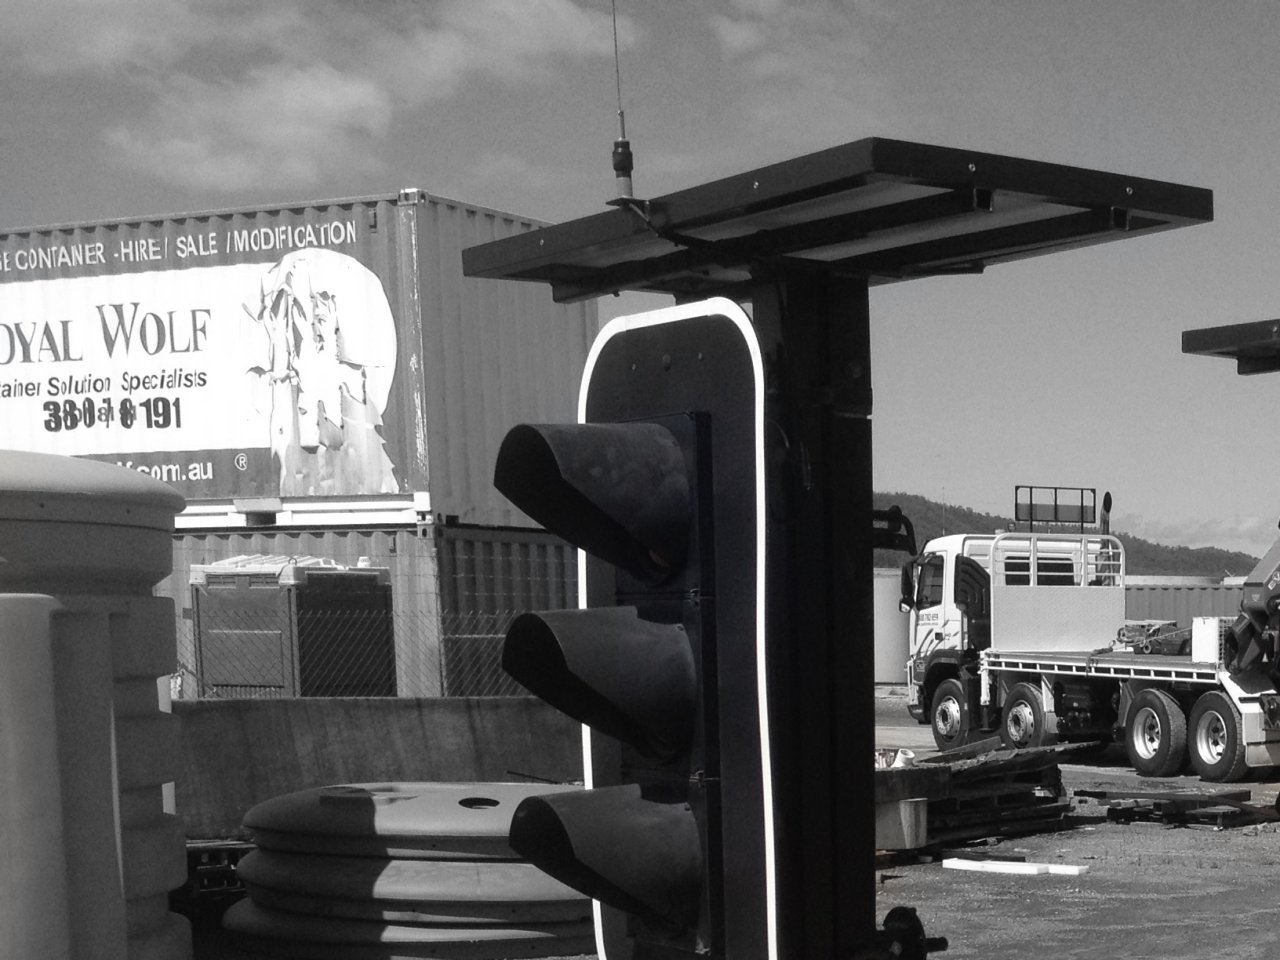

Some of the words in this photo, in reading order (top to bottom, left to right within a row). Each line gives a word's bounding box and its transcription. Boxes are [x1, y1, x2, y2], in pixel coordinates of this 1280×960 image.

[15, 242, 106, 270] CONTAINER
[176, 231, 218, 259] SALE
[47, 373, 111, 397] Solution
[121, 367, 207, 395] Specialists
